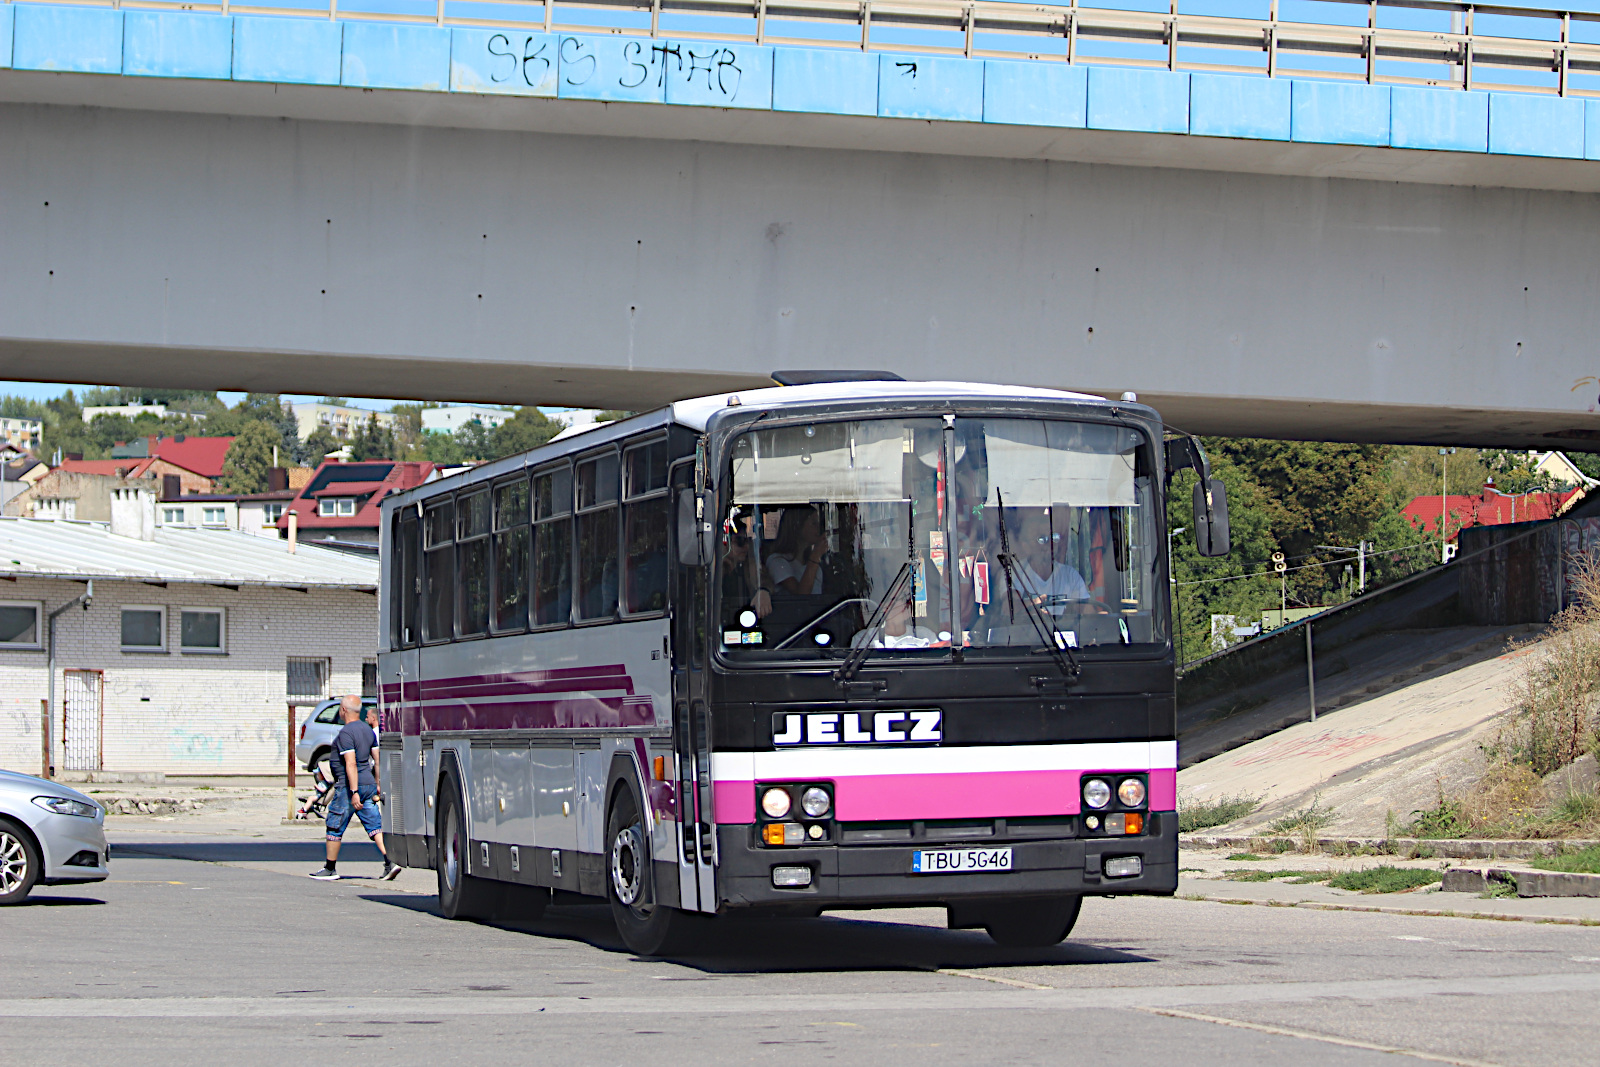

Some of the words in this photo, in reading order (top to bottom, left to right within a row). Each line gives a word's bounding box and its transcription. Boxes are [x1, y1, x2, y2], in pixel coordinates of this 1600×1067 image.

[487, 33, 597, 87] SKS
[773, 711, 941, 744] JELCZ
[924, 852, 961, 870] TBU
[967, 850, 1009, 868] 5G46
